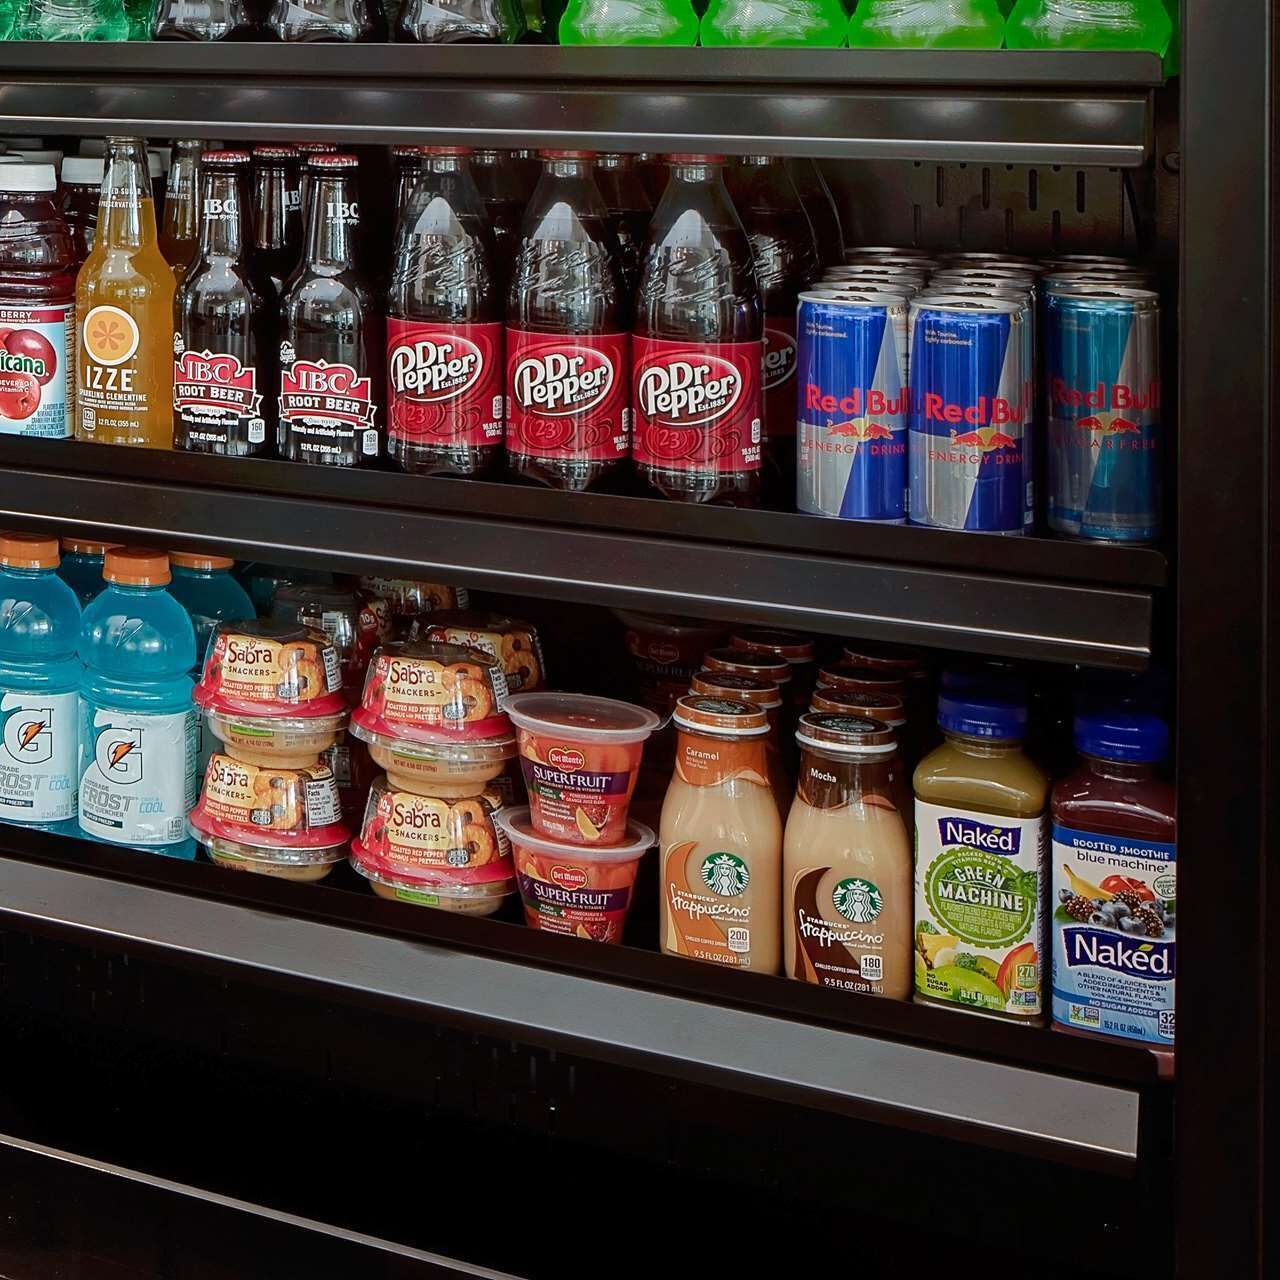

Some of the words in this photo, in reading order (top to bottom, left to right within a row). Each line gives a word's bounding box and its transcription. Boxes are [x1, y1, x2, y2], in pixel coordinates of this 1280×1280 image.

[204, 199, 237, 215] IBC
[326, 202, 359, 218] IBC
[416, 341, 450, 368] Dr
[187, 360, 231, 383] IBC
[392, 346, 475, 394] Pepper
[547, 353, 583, 382] Dr
[669, 362, 709, 392] Dr
[2, 379, 34, 387] BEVERAGE
[86, 366, 133, 392] IZZE
[299, 370, 347, 393] IBC
[516, 360, 607, 409] Pepper
[106, 392, 147, 402] CLEMENTINE
[178, 385, 205, 398] ROOT
[210, 387, 244, 402] BEER
[288, 396, 321, 408] ROOT
[325, 398, 360, 413] BEER
[640, 367, 732, 420] Pepper
[805, 384, 861, 414] Red
[866, 389, 910, 416] Bull
[1051, 377, 1105, 408] Red
[1111, 382, 1160, 410] Bull
[924, 392, 986, 424] Red
[808, 441, 860, 455] ENERGY
[870, 444, 905, 456] DRINK
[928, 451, 990, 465] ENERGY
[228, 641, 272, 665] Sabra
[228, 666, 271, 677] SNACKERS
[391, 661, 436, 685] Sabra
[391, 687, 435, 698] SNACKERS
[551, 754, 561, 762] Del
[562, 755, 582, 764] Monte
[685, 746, 719, 761] Caramel
[211, 760, 248, 788] Sabra
[533, 765, 608, 788] SUPERFRUIT
[810, 768, 837, 784] Mocha
[211, 785, 246, 801] SNACKERS
[139, 802, 165, 813] COOL
[393, 805, 440, 829] Sabra
[394, 829, 440, 842] SNACKERS
[946, 822, 1013, 851] Naked
[1073, 838, 1116, 853] BOOSTED
[1120, 846, 1170, 860] SMOOTHIE
[1076, 850, 1105, 864] blue
[954, 866, 1005, 889] GREEN
[534, 882, 609, 906] SUPERFRUIT
[671, 883, 749, 920] frappuccino
[677, 891, 715, 902] STARBUCKS
[938, 882, 1024, 911] MACHINE
[799, 909, 883, 947] frappuccino
[807, 916, 848, 929] STARBUCKS
[730, 930, 747, 941] 200
[863, 957, 880, 968] 180
[1074, 934, 1168, 974] Naked
[1019, 966, 1035, 977] 270
[1101, 1001, 1126, 1011] SUGAR
